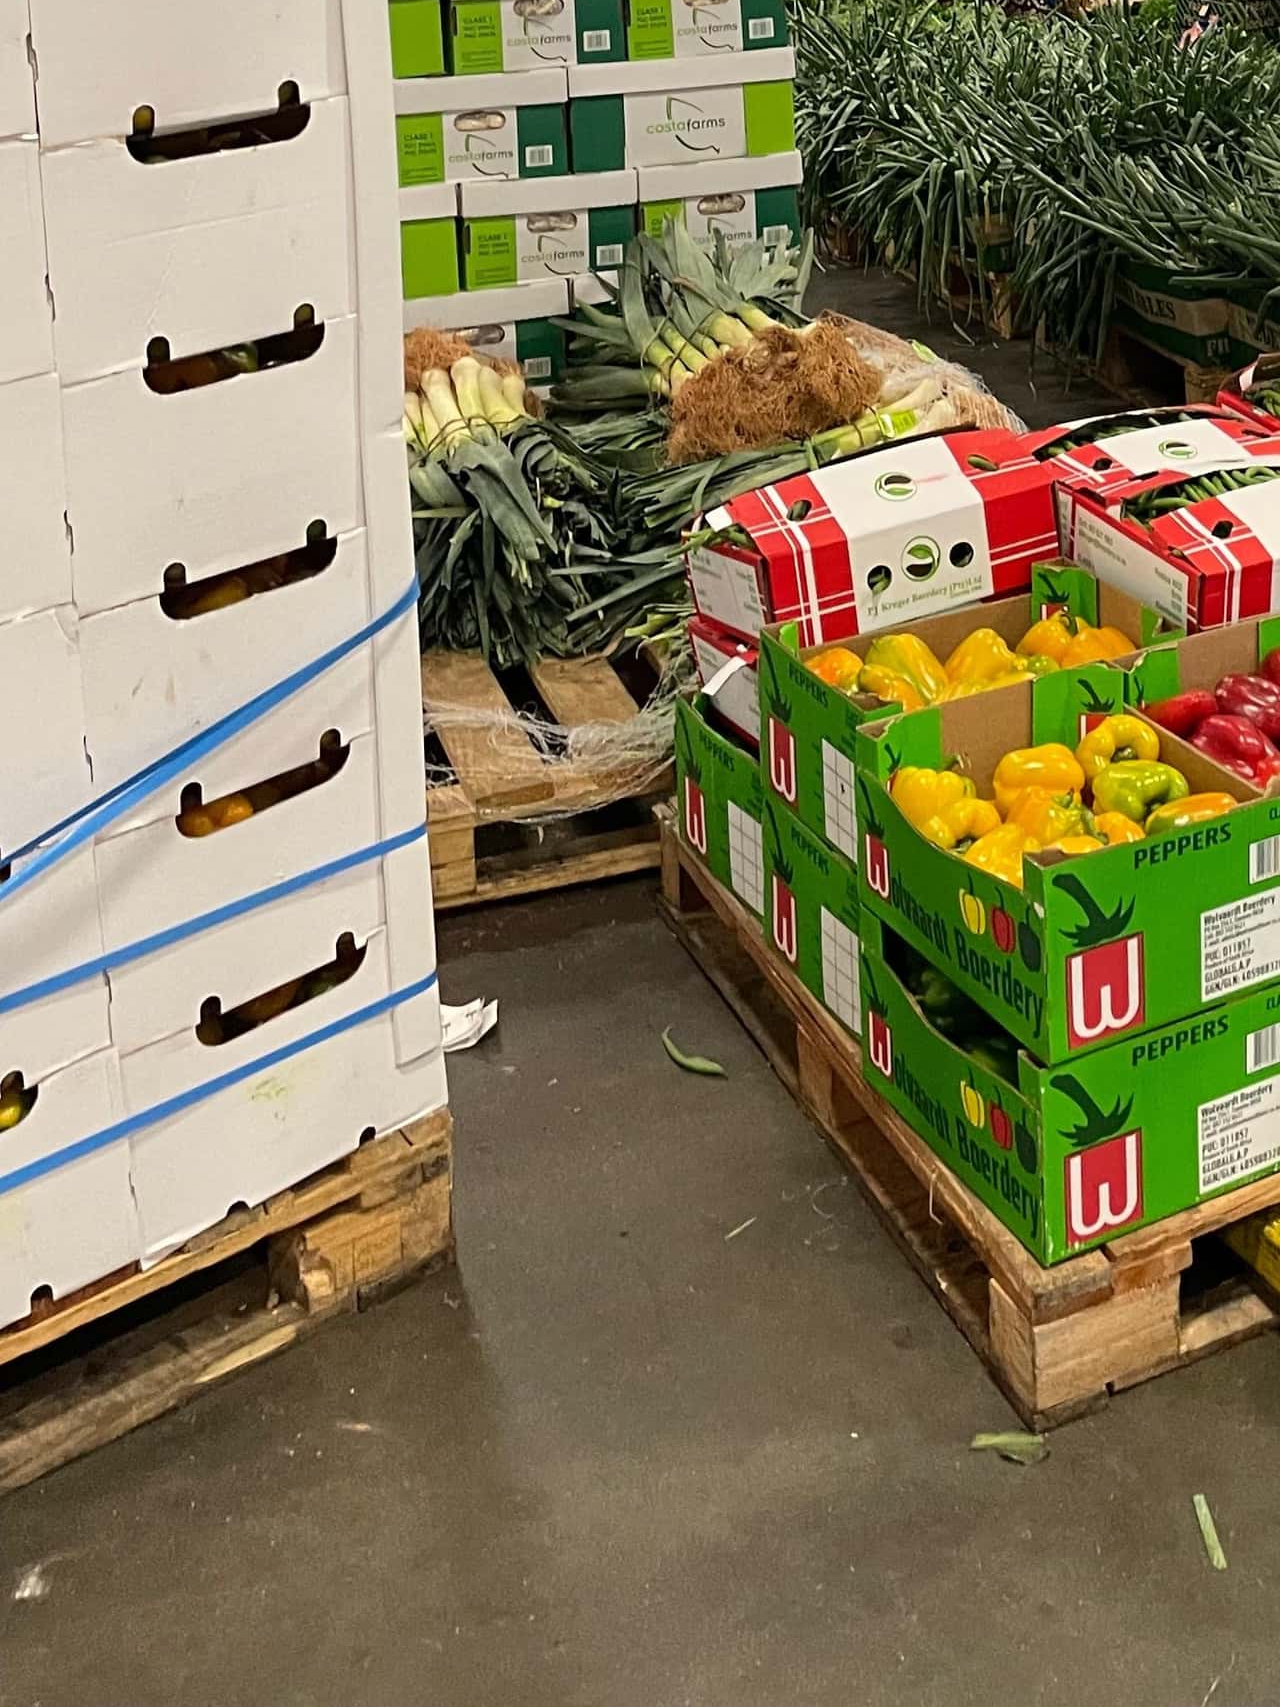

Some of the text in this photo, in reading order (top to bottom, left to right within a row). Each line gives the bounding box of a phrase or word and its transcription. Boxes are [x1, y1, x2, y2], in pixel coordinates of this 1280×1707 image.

[646, 116, 726, 135] costafarms
[1134, 823, 1232, 870] PEPPERS
[954, 926, 1043, 1039] Boerdery
[1132, 1015, 1229, 1067] PEPPERS
[956, 1116, 1040, 1239] Boerdery
